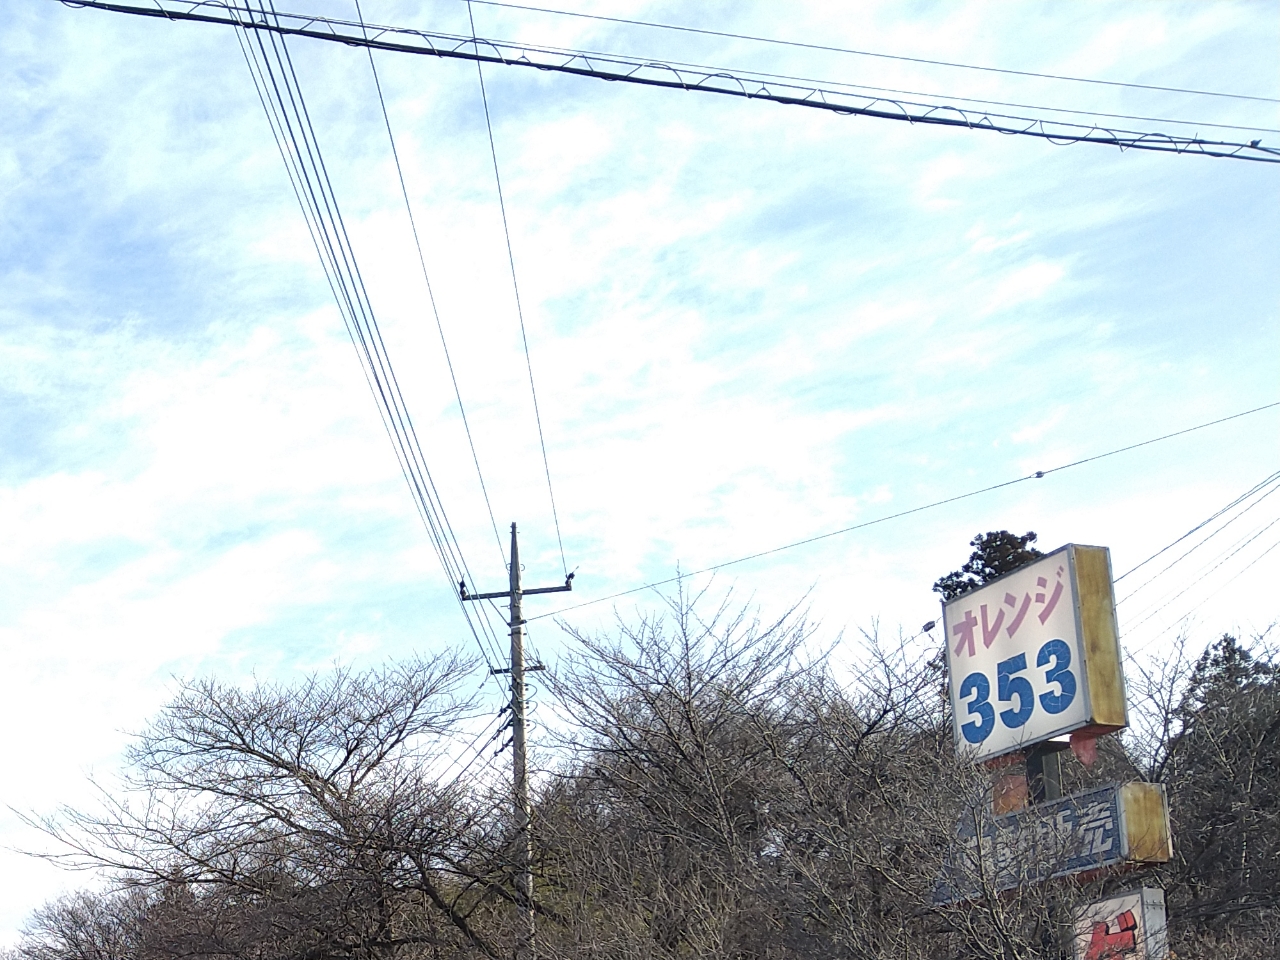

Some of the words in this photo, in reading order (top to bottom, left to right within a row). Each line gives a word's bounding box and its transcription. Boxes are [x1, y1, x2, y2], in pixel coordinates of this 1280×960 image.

[952, 565, 1065, 658] オレンジ
[958, 638, 1078, 745] 353
